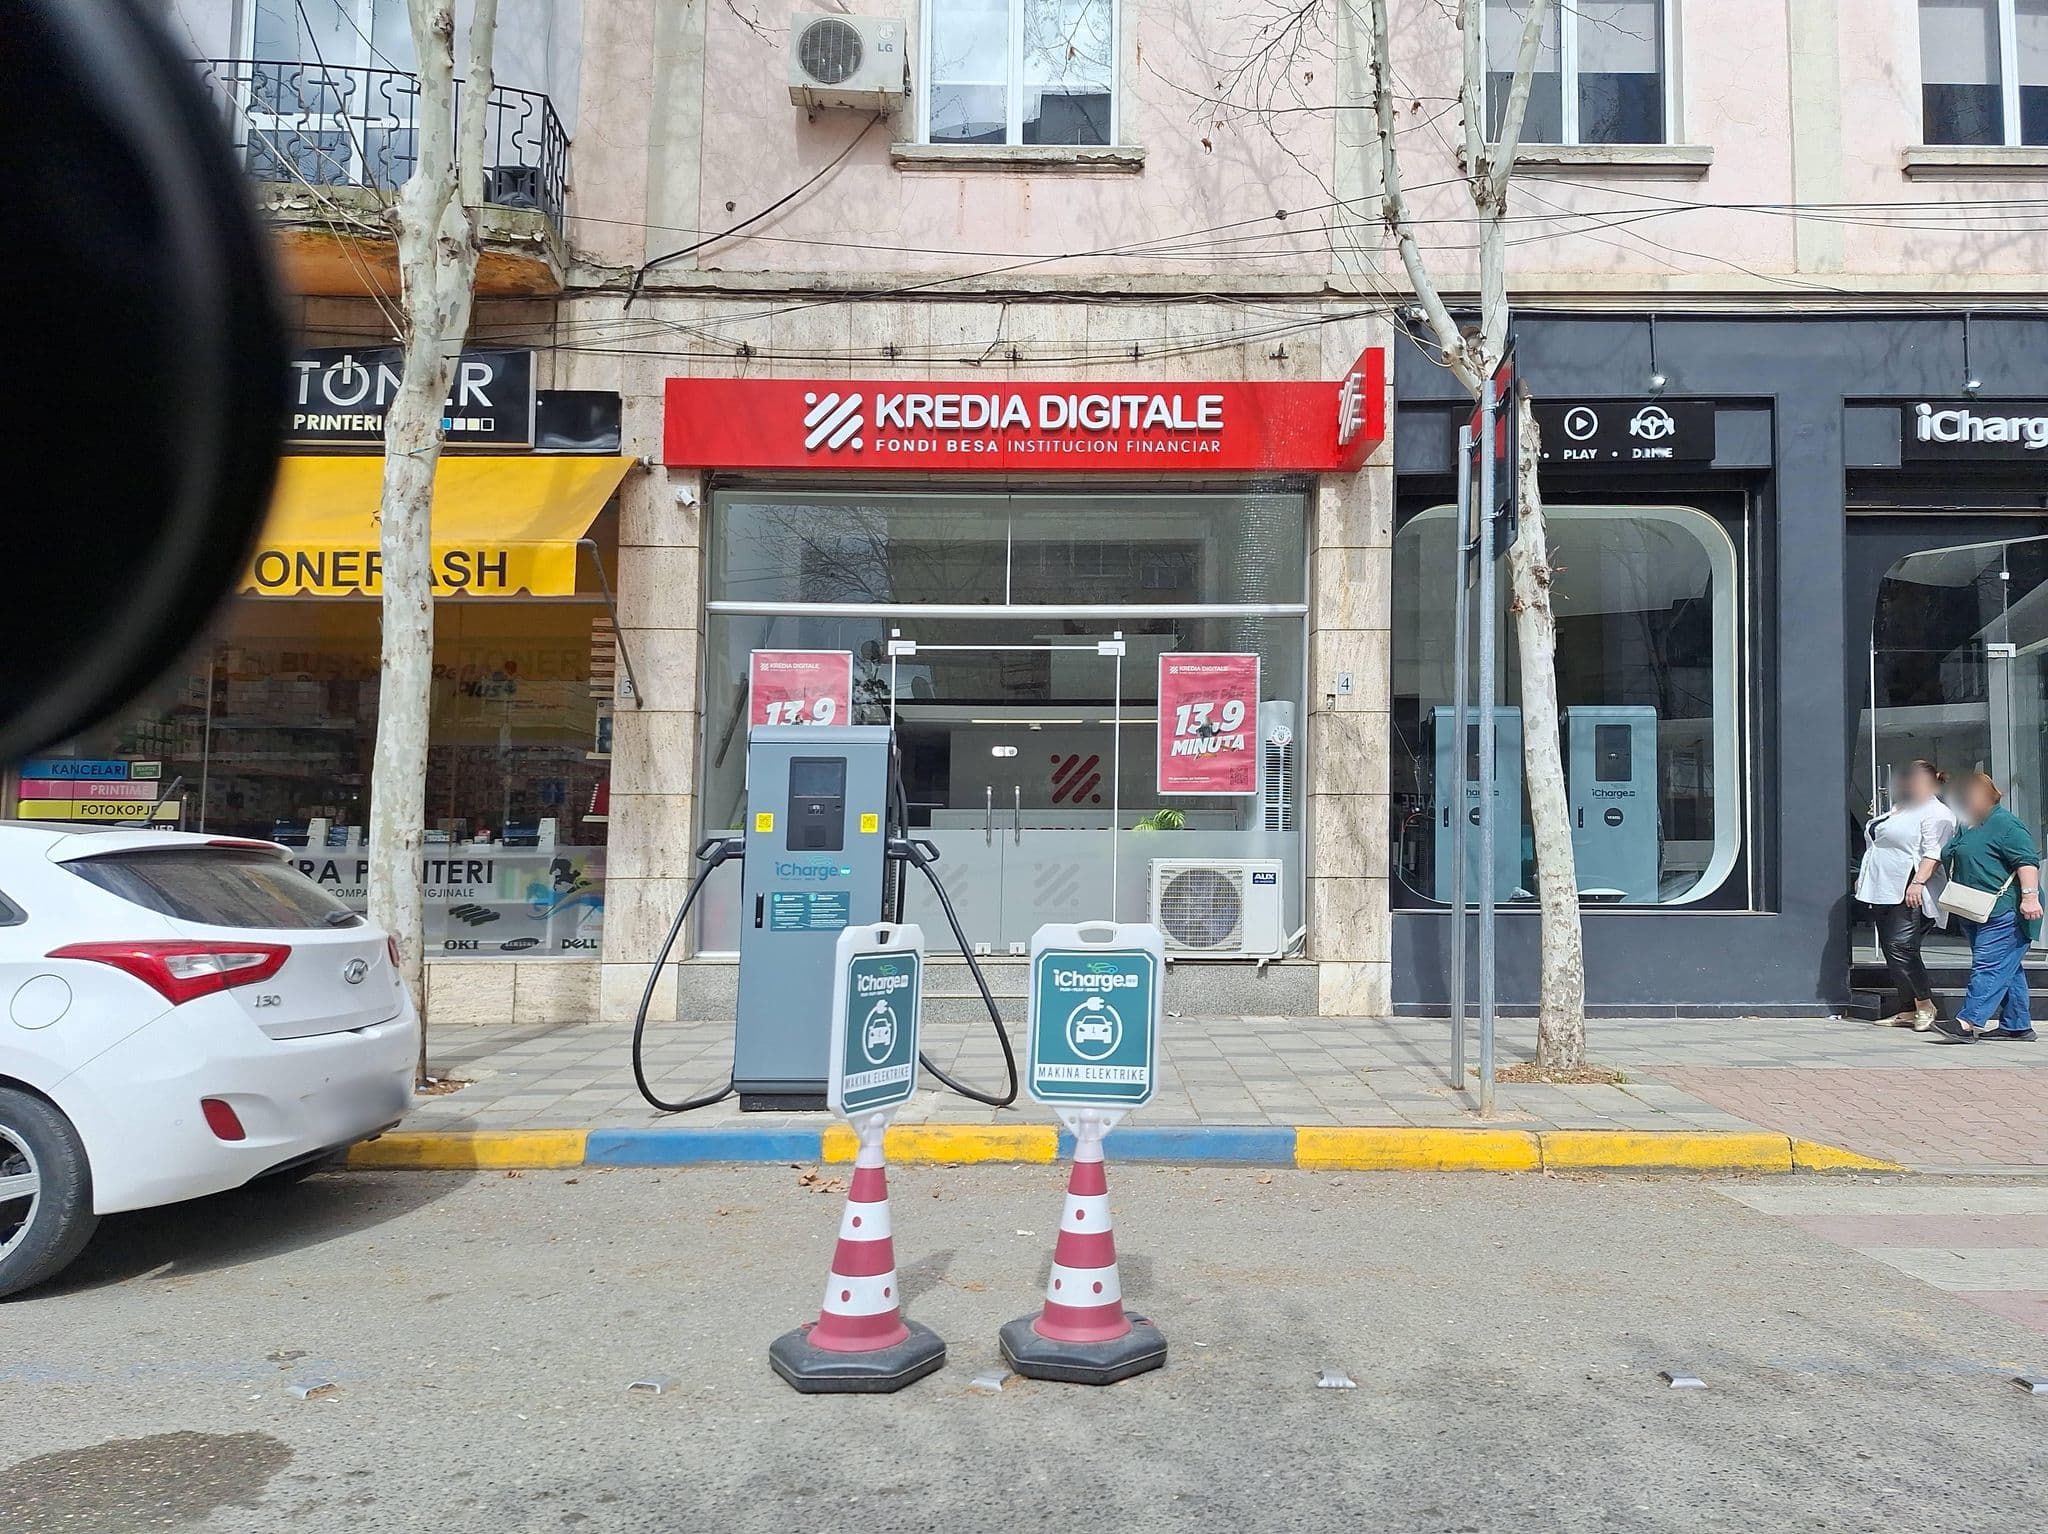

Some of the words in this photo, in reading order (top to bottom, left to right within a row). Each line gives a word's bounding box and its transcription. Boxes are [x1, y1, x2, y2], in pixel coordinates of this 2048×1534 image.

[877, 43, 893, 53] LG
[290, 354, 494, 407] TONR
[876, 393, 1032, 430] KREDIA
[1038, 394, 1224, 431] DIGITALE
[293, 413, 383, 432] PRINTERI
[1915, 402, 2048, 450] iCharg
[876, 438, 937, 452] FONDI
[946, 438, 999, 452] BESA
[1007, 438, 1118, 453] INSTITUCION
[1126, 439, 1221, 453] FINANCIAR
[1563, 448, 1598, 460] PLAY
[623, 679, 633, 694] 3
[1341, 676, 1350, 690] 4
[1175, 700, 1245, 736] 13.9
[1171, 734, 1245, 758] MINUTA
[51, 764, 126, 776] KANCELARI
[90, 784, 149, 796] PRINTIME
[288, 860, 341, 884] RA
[356, 860, 494, 884] PTERI
[423, 888, 475, 898] IGJINALE
[444, 939, 479, 950] OKI
[562, 938, 598, 949] DELL
[846, 1073, 871, 1089] MAKINA
[873, 1066, 910, 1083] ELEKTRIKE
[1038, 1066, 1080, 1079] MAKINA
[1085, 1067, 1145, 1081] ELEKTRIKE
